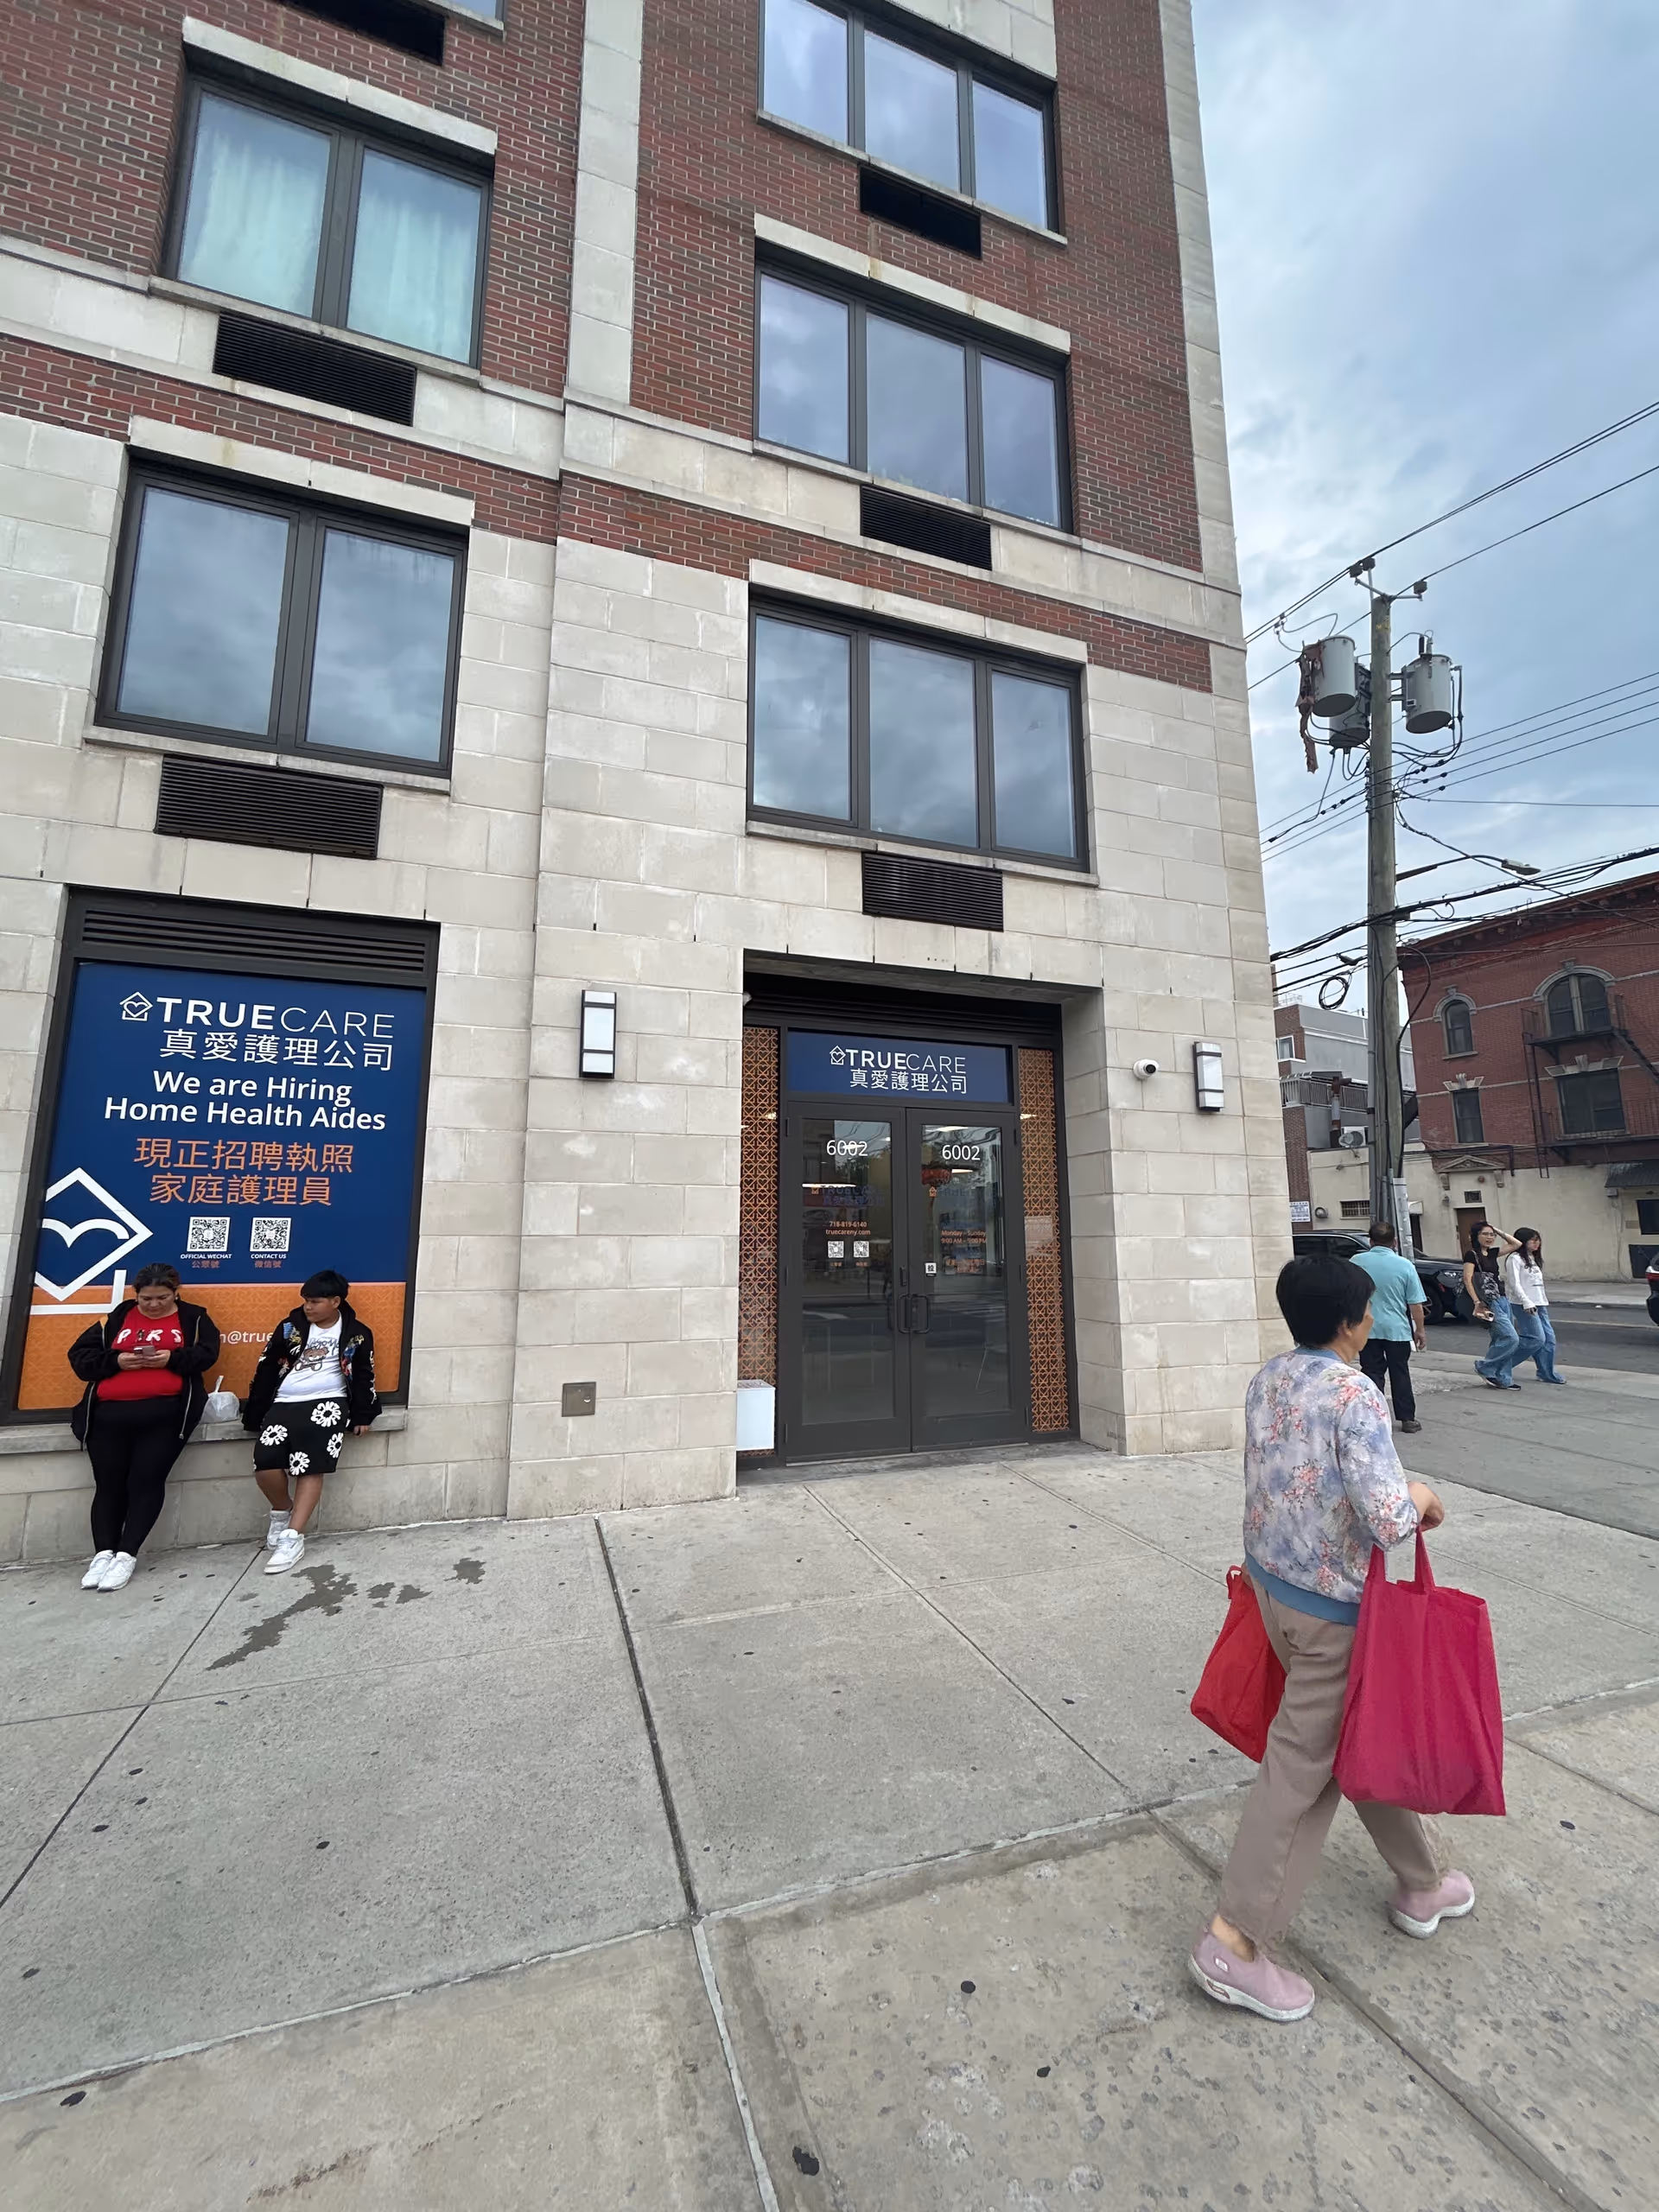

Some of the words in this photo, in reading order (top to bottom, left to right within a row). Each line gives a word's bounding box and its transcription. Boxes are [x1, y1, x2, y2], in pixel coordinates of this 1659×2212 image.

[156, 995, 395, 1039] TRUECARE
[159, 1028, 392, 1071] 真愛護理公司
[845, 1048, 966, 1074] TRUECARE
[153, 1071, 201, 1094] We
[209, 1078, 257, 1097] are
[267, 1077, 352, 1107] Hiring
[849, 1068, 967, 1094] 真愛護理公司
[105, 1096, 198, 1122] Home
[207, 1102, 302, 1127] Health
[310, 1106, 386, 1130] Aides
[134, 1137, 353, 1173] 現正招聘執照
[826, 1140, 868, 1156] 6002
[942, 1144, 981, 1160] 6002
[149, 1173, 332, 1206] 家庭護理員
